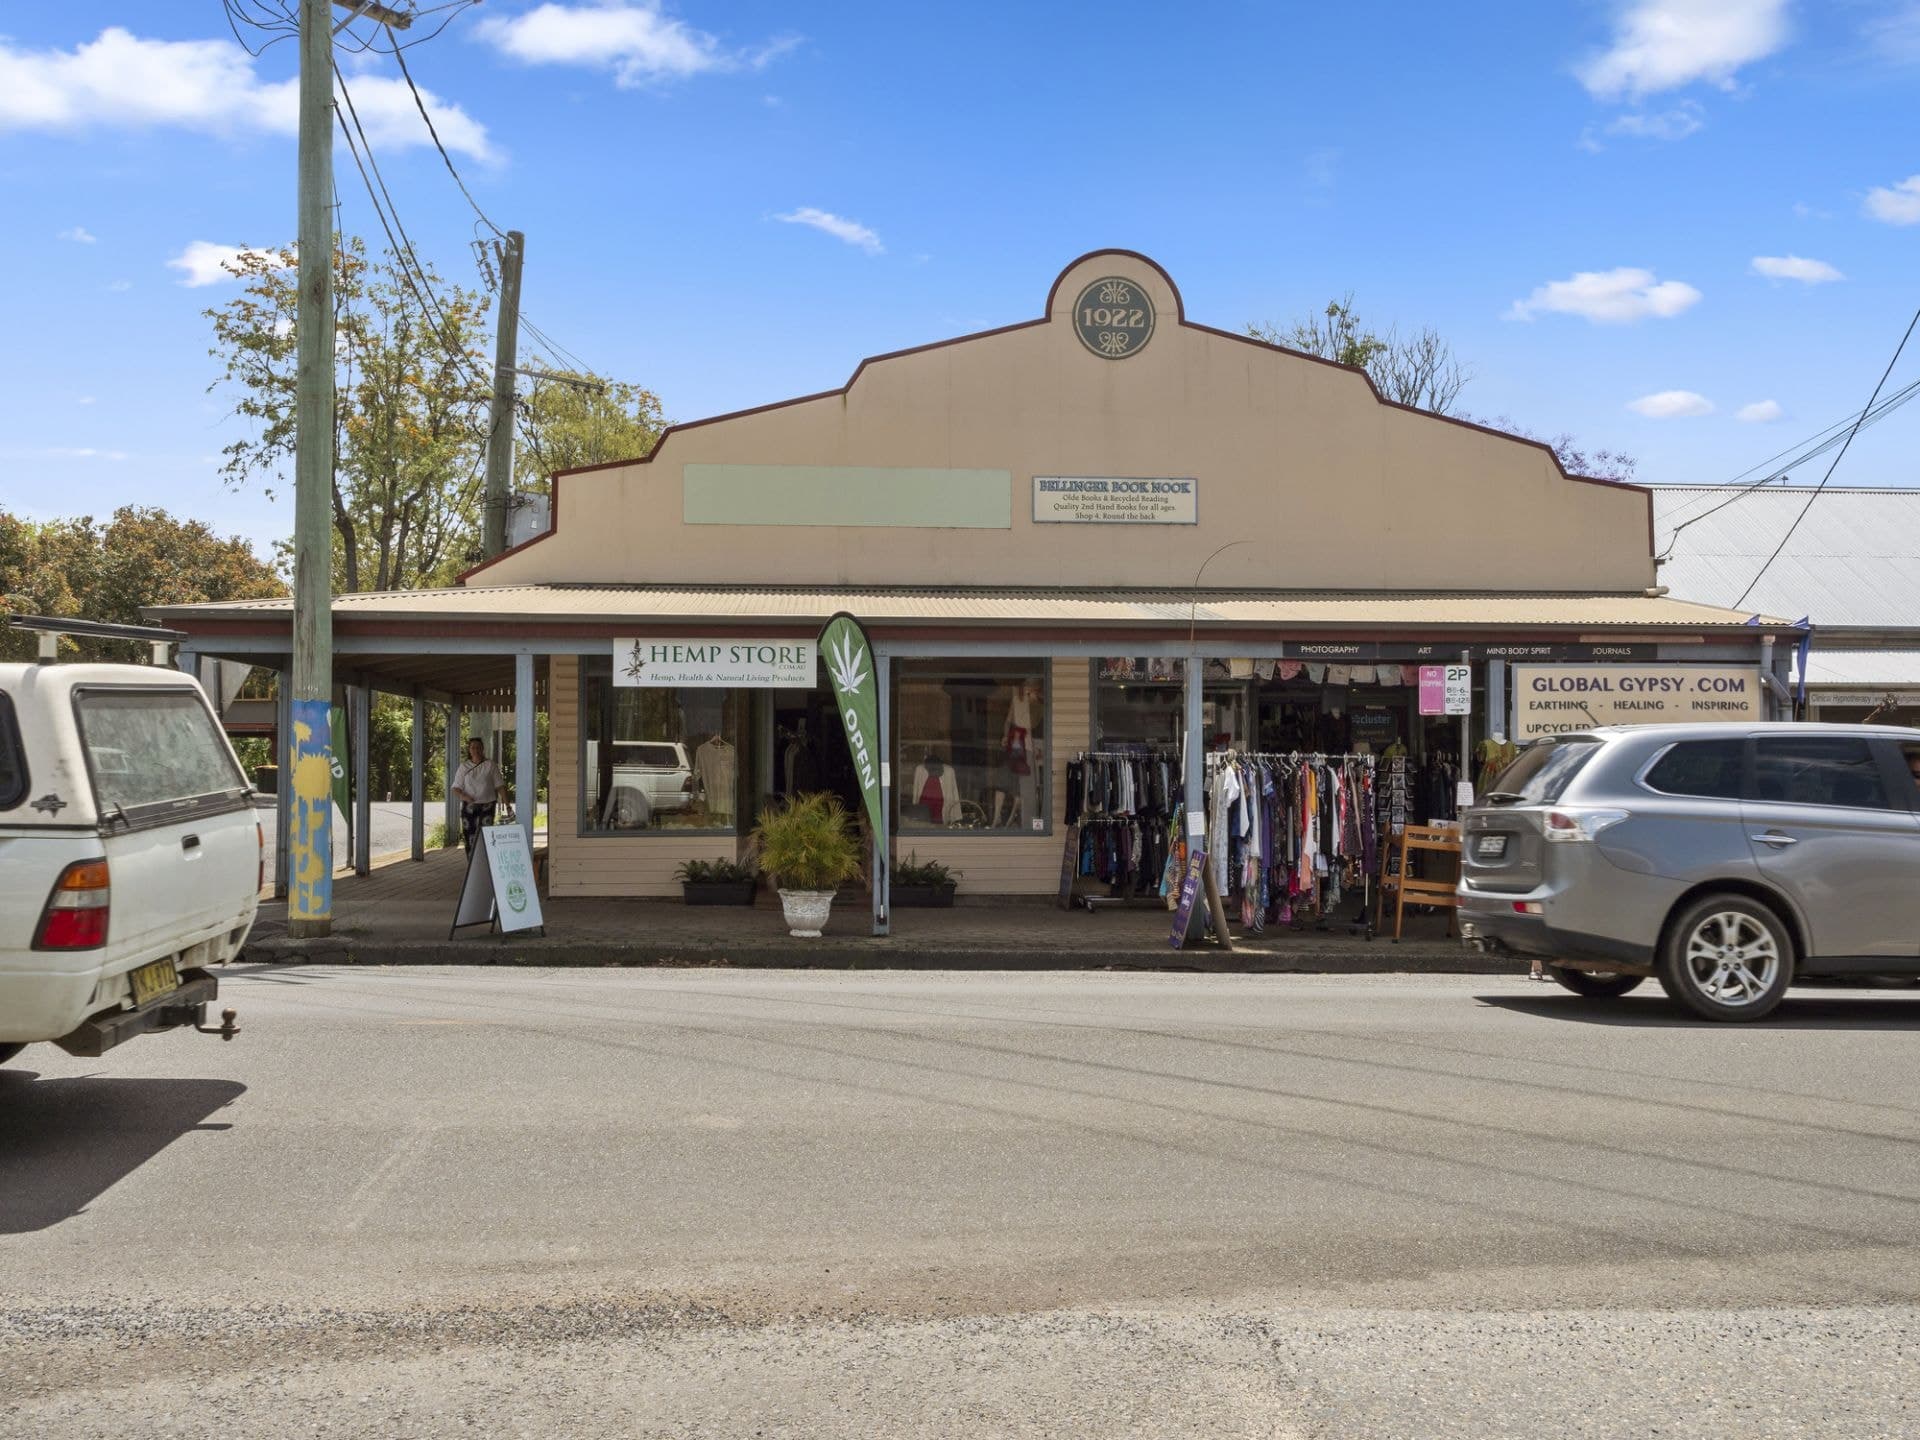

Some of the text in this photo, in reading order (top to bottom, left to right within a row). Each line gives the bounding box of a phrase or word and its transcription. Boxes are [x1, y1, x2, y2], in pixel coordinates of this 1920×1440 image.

[1083, 308, 1144, 327] 1922
[1039, 480, 1191, 493] BELLINGER BOOK NOOK
[1110, 494, 1139, 503] Recycled
[1141, 495, 1169, 504] Reading
[1053, 503, 1079, 511] Quality
[1096, 503, 1114, 511] Hand
[1116, 503, 1137, 511] Books
[1138, 503, 1149, 511] for
[1150, 503, 1159, 511] all
[1075, 512, 1093, 520] Shop
[1140, 513, 1156, 521] back
[650, 645, 807, 664] HEMP STORE
[1300, 645, 1360, 654] PHOTOGRAPHY
[1486, 647, 1552, 655] MIND BODY SPIRIT
[1592, 647, 1631, 655] JOURNALS
[678, 673, 703, 681] Health
[715, 674, 745, 682] Natural
[746, 674, 770, 683] Living
[771, 674, 805, 682] Products
[1426, 670, 1437, 678] NO
[1447, 668, 1468, 681] 2P
[1532, 677, 1614, 692] GLOBAL
[1619, 677, 1685, 693] GYPSY
[1529, 701, 1588, 710] EARTHING
[1613, 701, 1664, 710] HEALING
[1691, 701, 1749, 711] INSPIRING
[845, 708, 876, 790] OPEN
